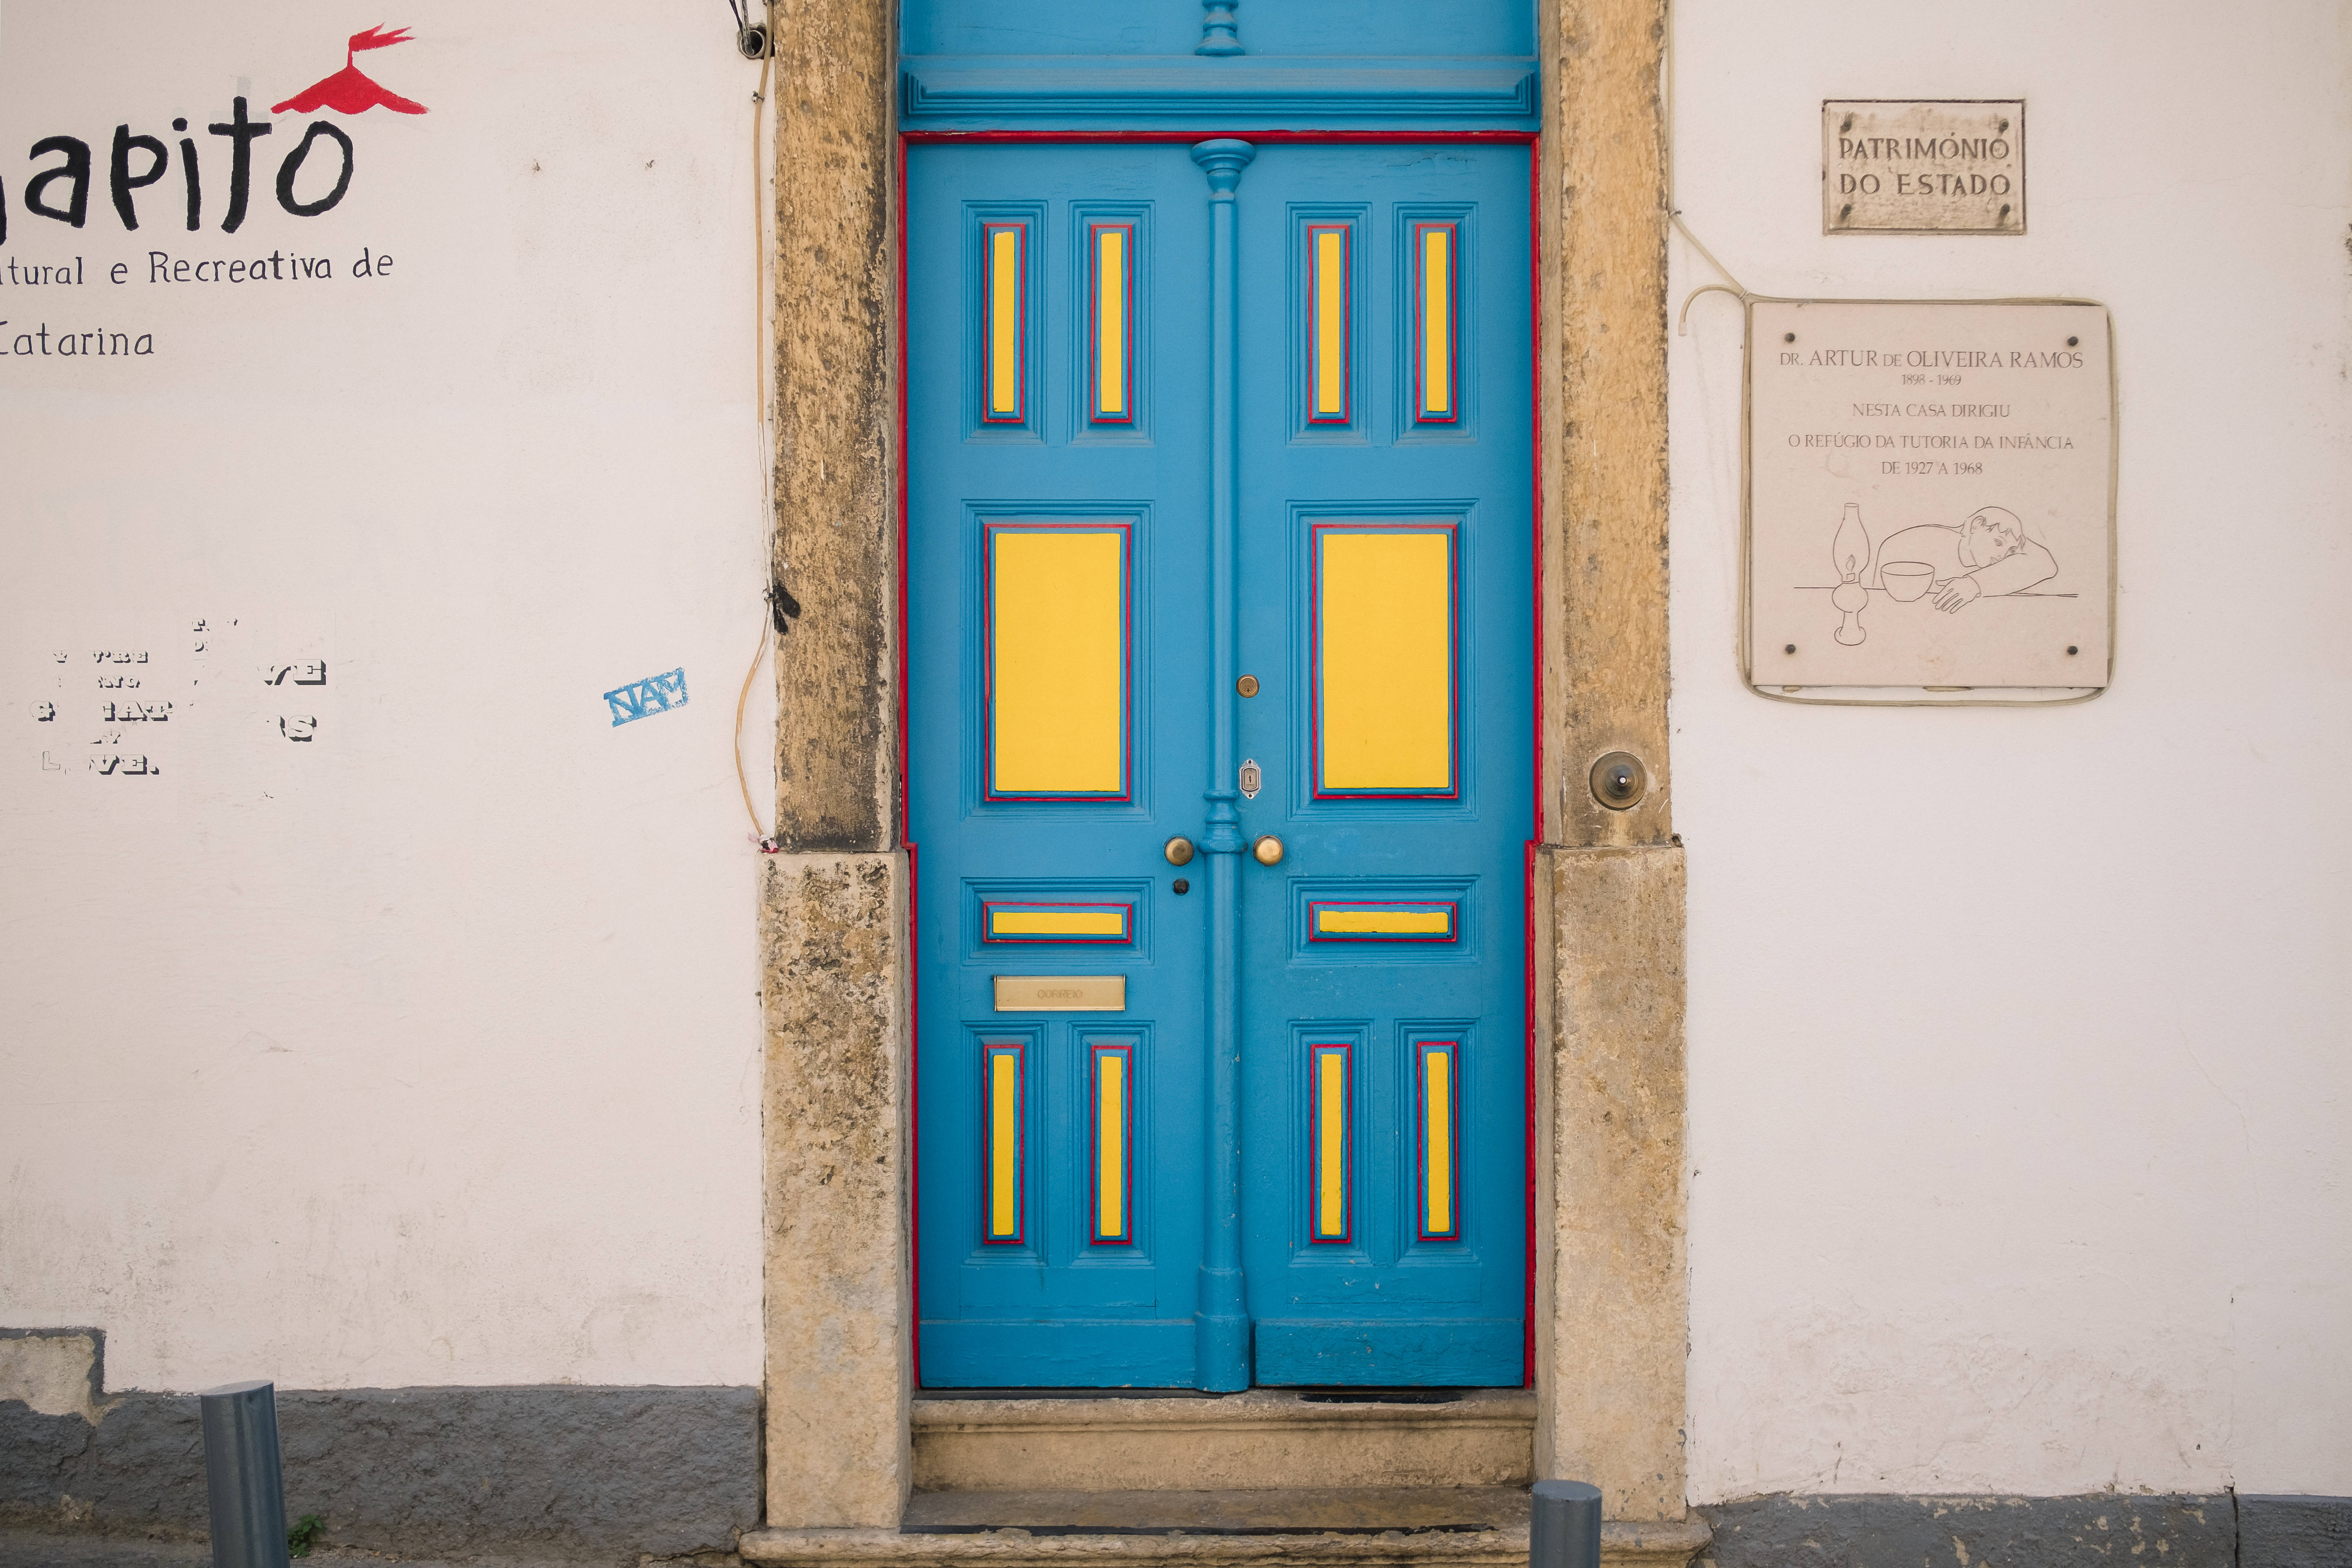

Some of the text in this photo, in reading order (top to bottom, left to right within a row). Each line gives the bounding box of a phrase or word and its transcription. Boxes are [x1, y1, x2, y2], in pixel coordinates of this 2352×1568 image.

[1839, 132, 2009, 160] PATRIMÓNIO
[0, 96, 353, 246] apito
[1840, 173, 2011, 195] DO ESTADO
[0, 247, 393, 285] tural e Recreativa de
[1780, 350, 2084, 368] DR. ARTUR DE OLIVEIRA RAMOS
[1901, 373, 1926, 385] 1898
[1937, 373, 1961, 386] 1969
[1852, 403, 2011, 417] NESTA CASA DIRIGIU
[1788, 432, 2074, 449] O REFÚGIO DA TUTORIA DA INFÂNCIA
[1881, 461, 1983, 475] DE 1927 A 1968
[1037, 989, 1083, 999] CORREIO
